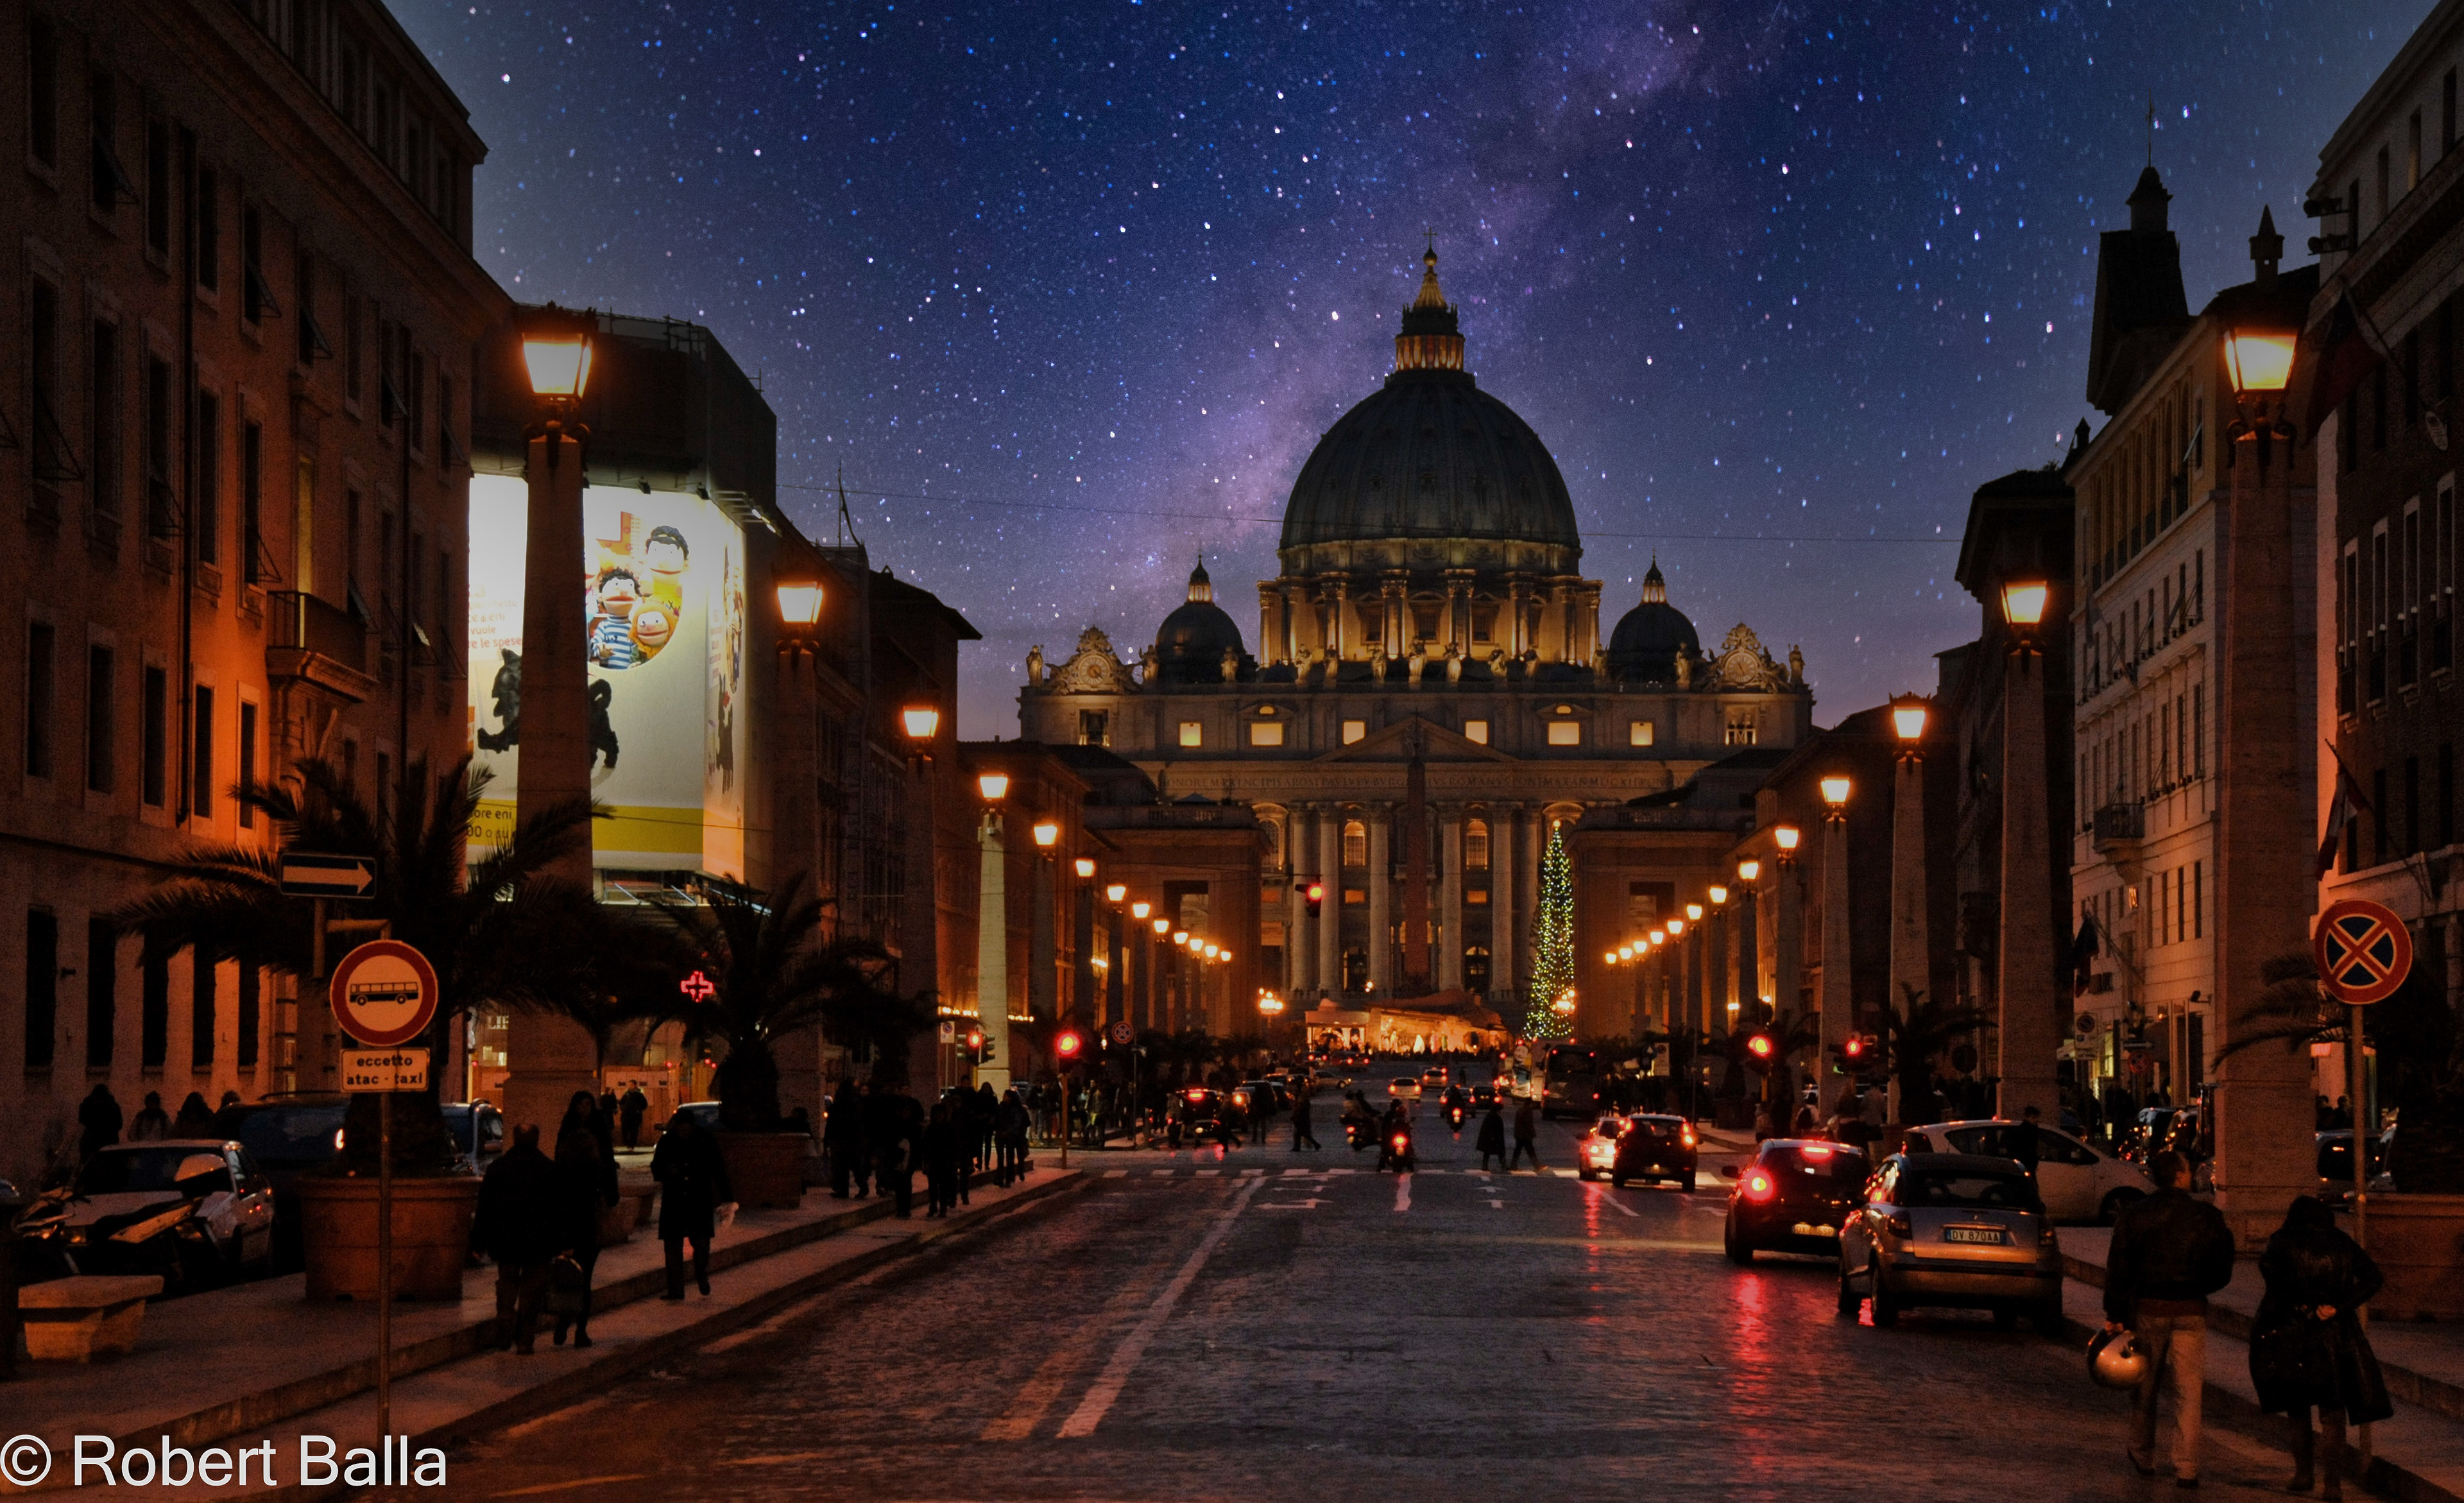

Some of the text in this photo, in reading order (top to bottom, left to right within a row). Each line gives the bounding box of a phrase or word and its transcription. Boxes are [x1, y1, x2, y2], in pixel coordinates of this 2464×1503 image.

[470, 624, 496, 635] vuole
[480, 638, 490, 648] le
[492, 637, 522, 649] spese
[1166, 777, 1219, 787] ONOREM
[495, 807, 511, 820] eni
[357, 1054, 413, 1066] eccetto
[347, 1074, 379, 1085] atac
[394, 1072, 422, 1084] taxi
[1952, 1230, 1999, 1241] DV 870AA
